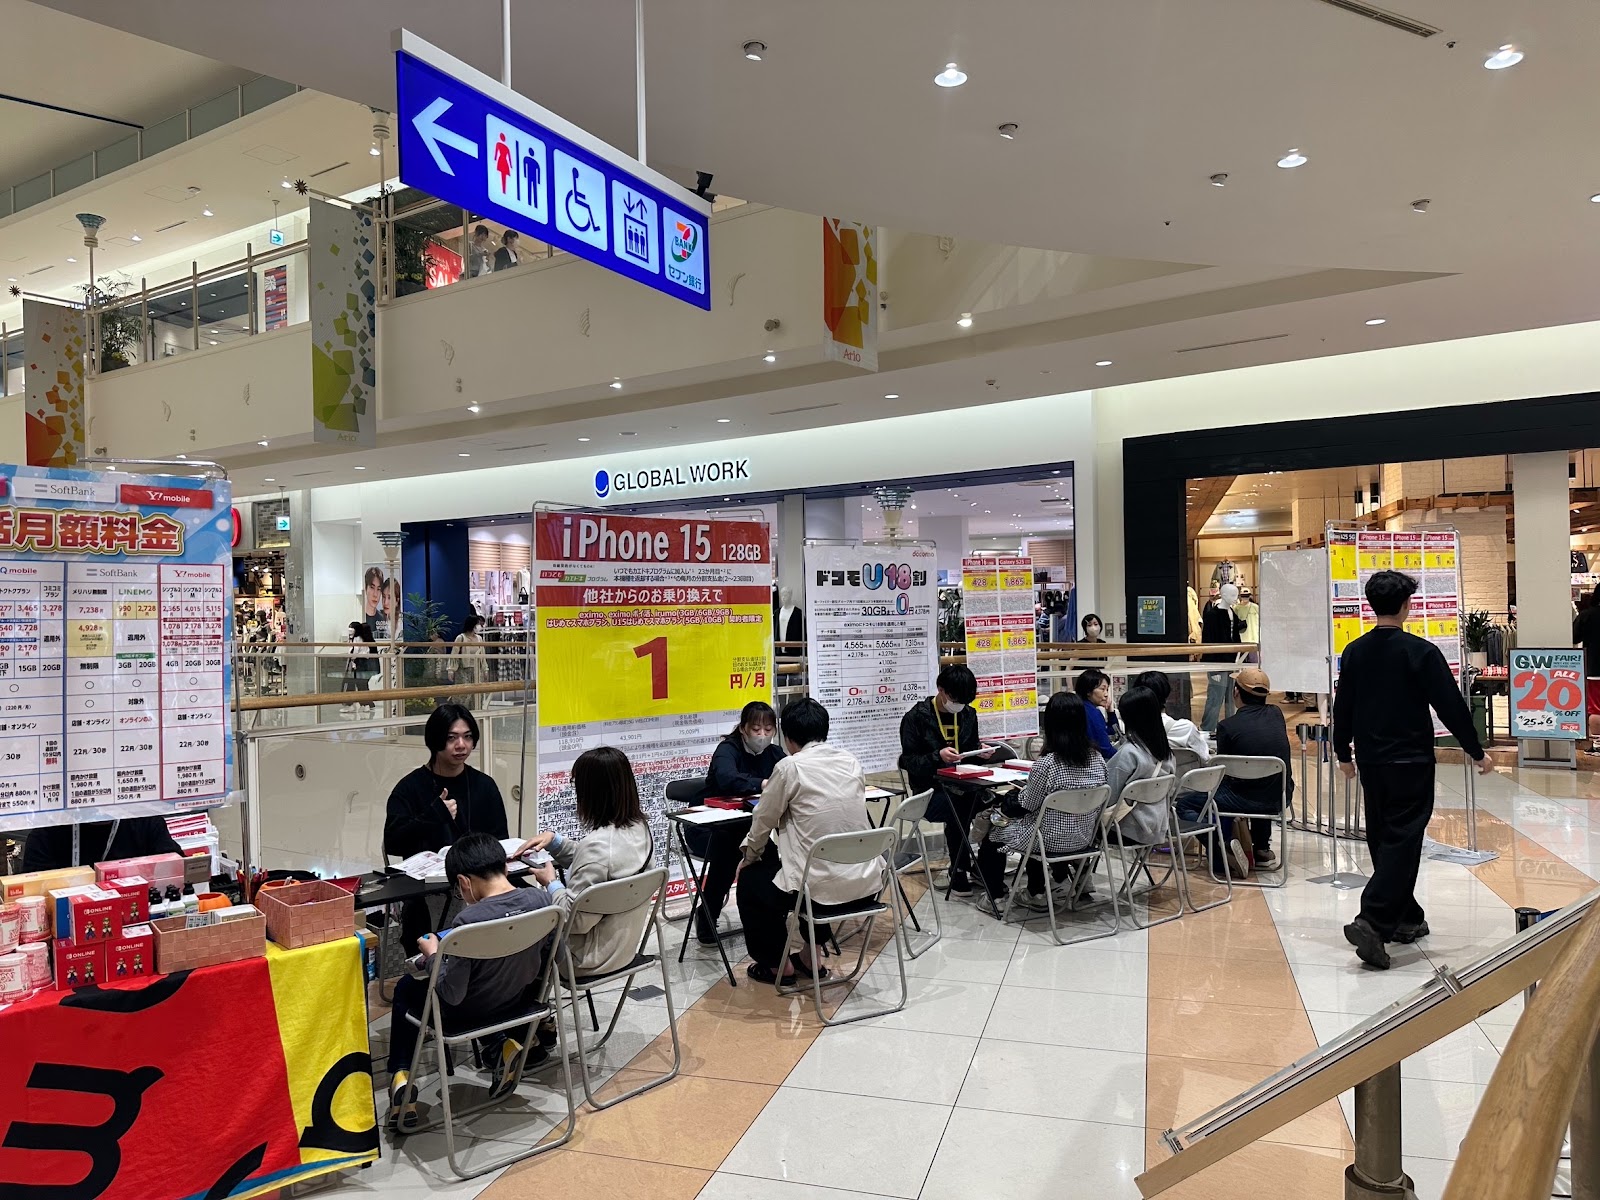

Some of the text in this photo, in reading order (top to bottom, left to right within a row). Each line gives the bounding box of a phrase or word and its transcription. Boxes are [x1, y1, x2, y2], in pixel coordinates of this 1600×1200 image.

[675, 236, 693, 252] BANK
[668, 264, 702, 290] セブン銀行
[843, 349, 861, 362] Ario
[613, 459, 749, 491] GLOBAL WORK
[50, 484, 96, 496] SoftBank
[679, 522, 712, 562] 15
[720, 543, 762, 561] 128GB
[911, 550, 935, 558] docomo
[9, 567, 38, 575] mobile
[99, 568, 138, 578] SoftBank
[816, 562, 927, 590] ドコモU18割
[972, 577, 988, 587] 428
[118, 588, 153, 596] LINEMO
[582, 588, 723, 604] 他社からのお乗り換えで
[42, 604, 62, 612] 3,278
[976, 638, 991, 648] 428
[1555, 654, 1582, 662] FAIR!
[18, 664, 37, 672] 15GB
[42, 663, 61, 671] 20GB
[633, 636, 669, 700] 1
[1553, 670, 1576, 679] ALL
[1513, 671, 1582, 711] 20
[89, 905, 113, 914] ONLINE
[121, 942, 144, 950] ONLINE
[72, 950, 96, 958] ONLINE
